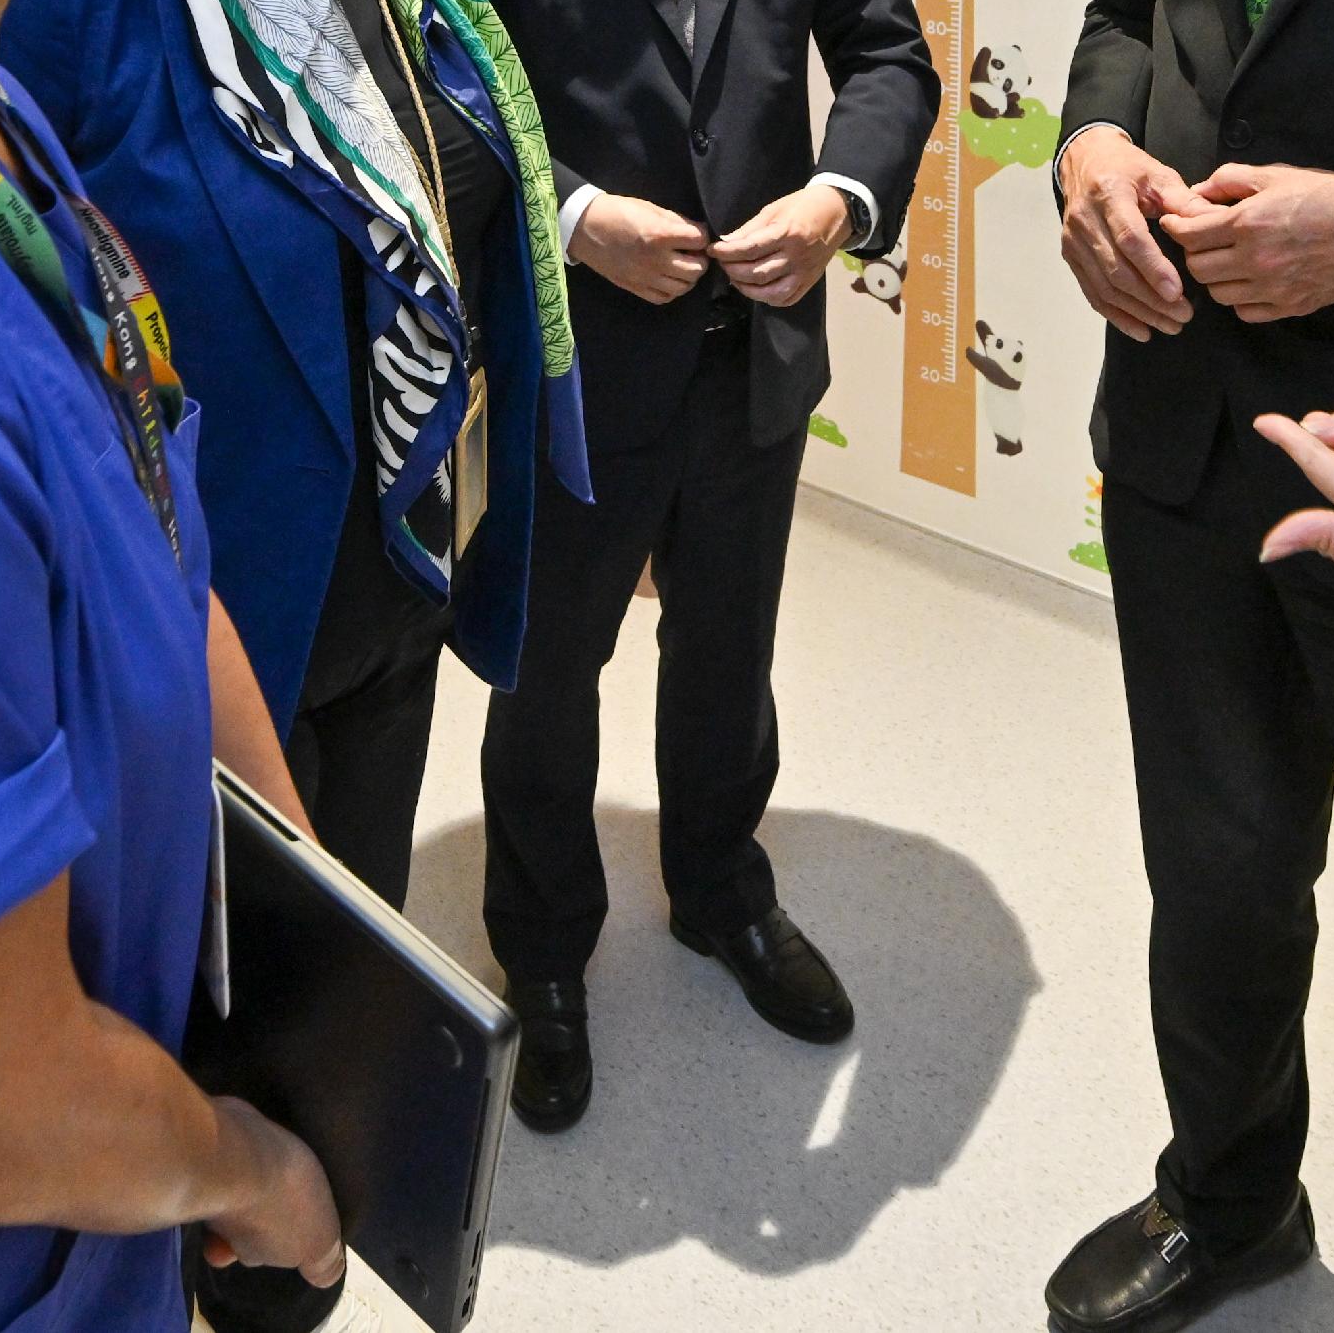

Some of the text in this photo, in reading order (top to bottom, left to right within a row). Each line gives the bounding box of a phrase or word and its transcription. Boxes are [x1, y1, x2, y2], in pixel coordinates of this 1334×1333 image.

[925, 21, 946, 36] 80
[923, 197, 943, 211] 50
[78, 207, 130, 279] Neostigmine
[921, 255, 942, 270] 40
[921, 312, 941, 326] 30
[114, 310, 138, 370] Kong
[920, 368, 940, 383] 20
